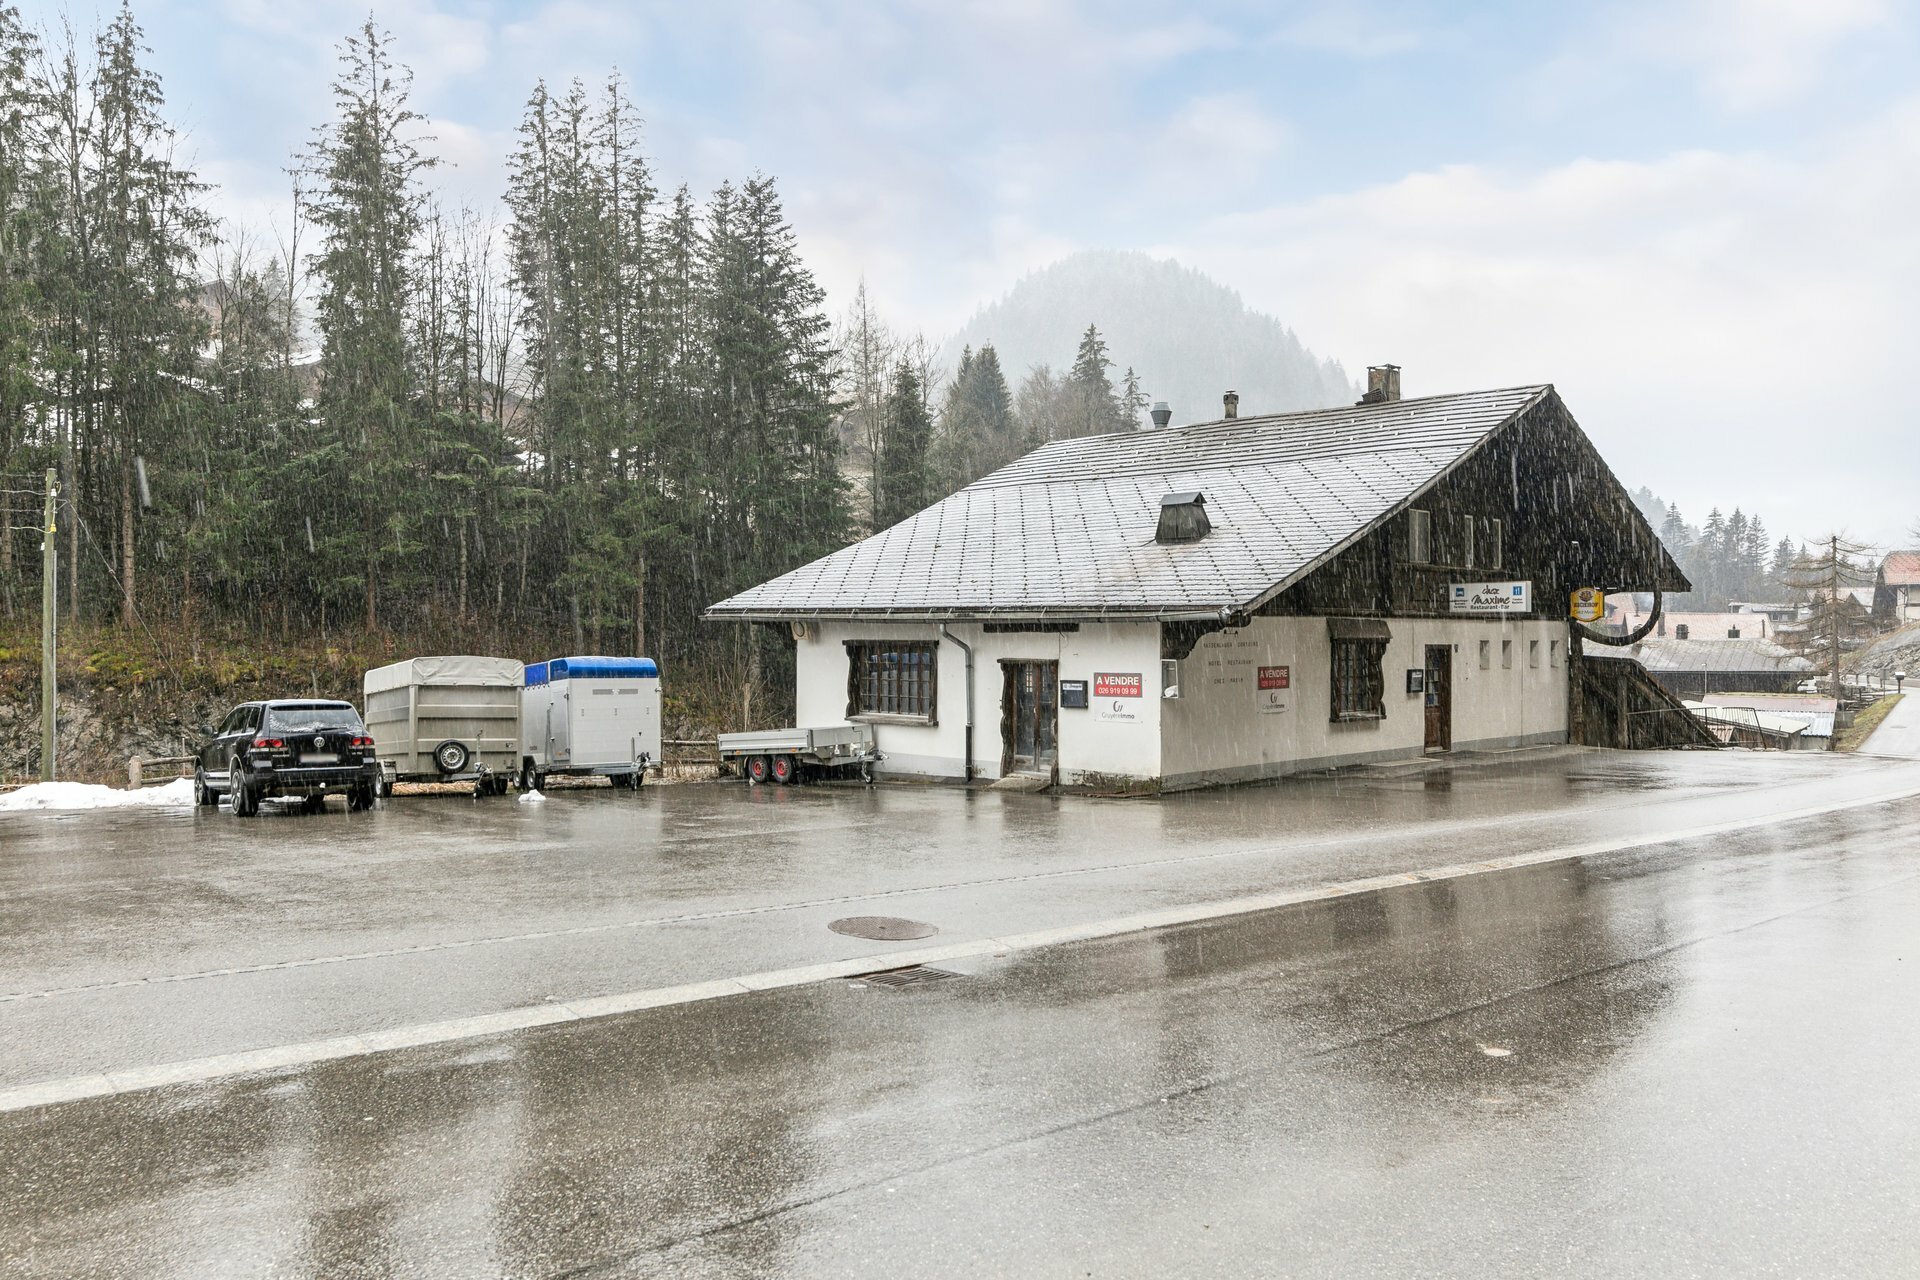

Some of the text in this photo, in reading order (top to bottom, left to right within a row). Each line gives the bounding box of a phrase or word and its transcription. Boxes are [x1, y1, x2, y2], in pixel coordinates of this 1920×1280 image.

[1482, 585, 1500, 595] chez
[1471, 594, 1510, 605] Maxime
[1260, 669, 1288, 678] A VENDRE
[1096, 676, 1140, 685] A VENDRE
